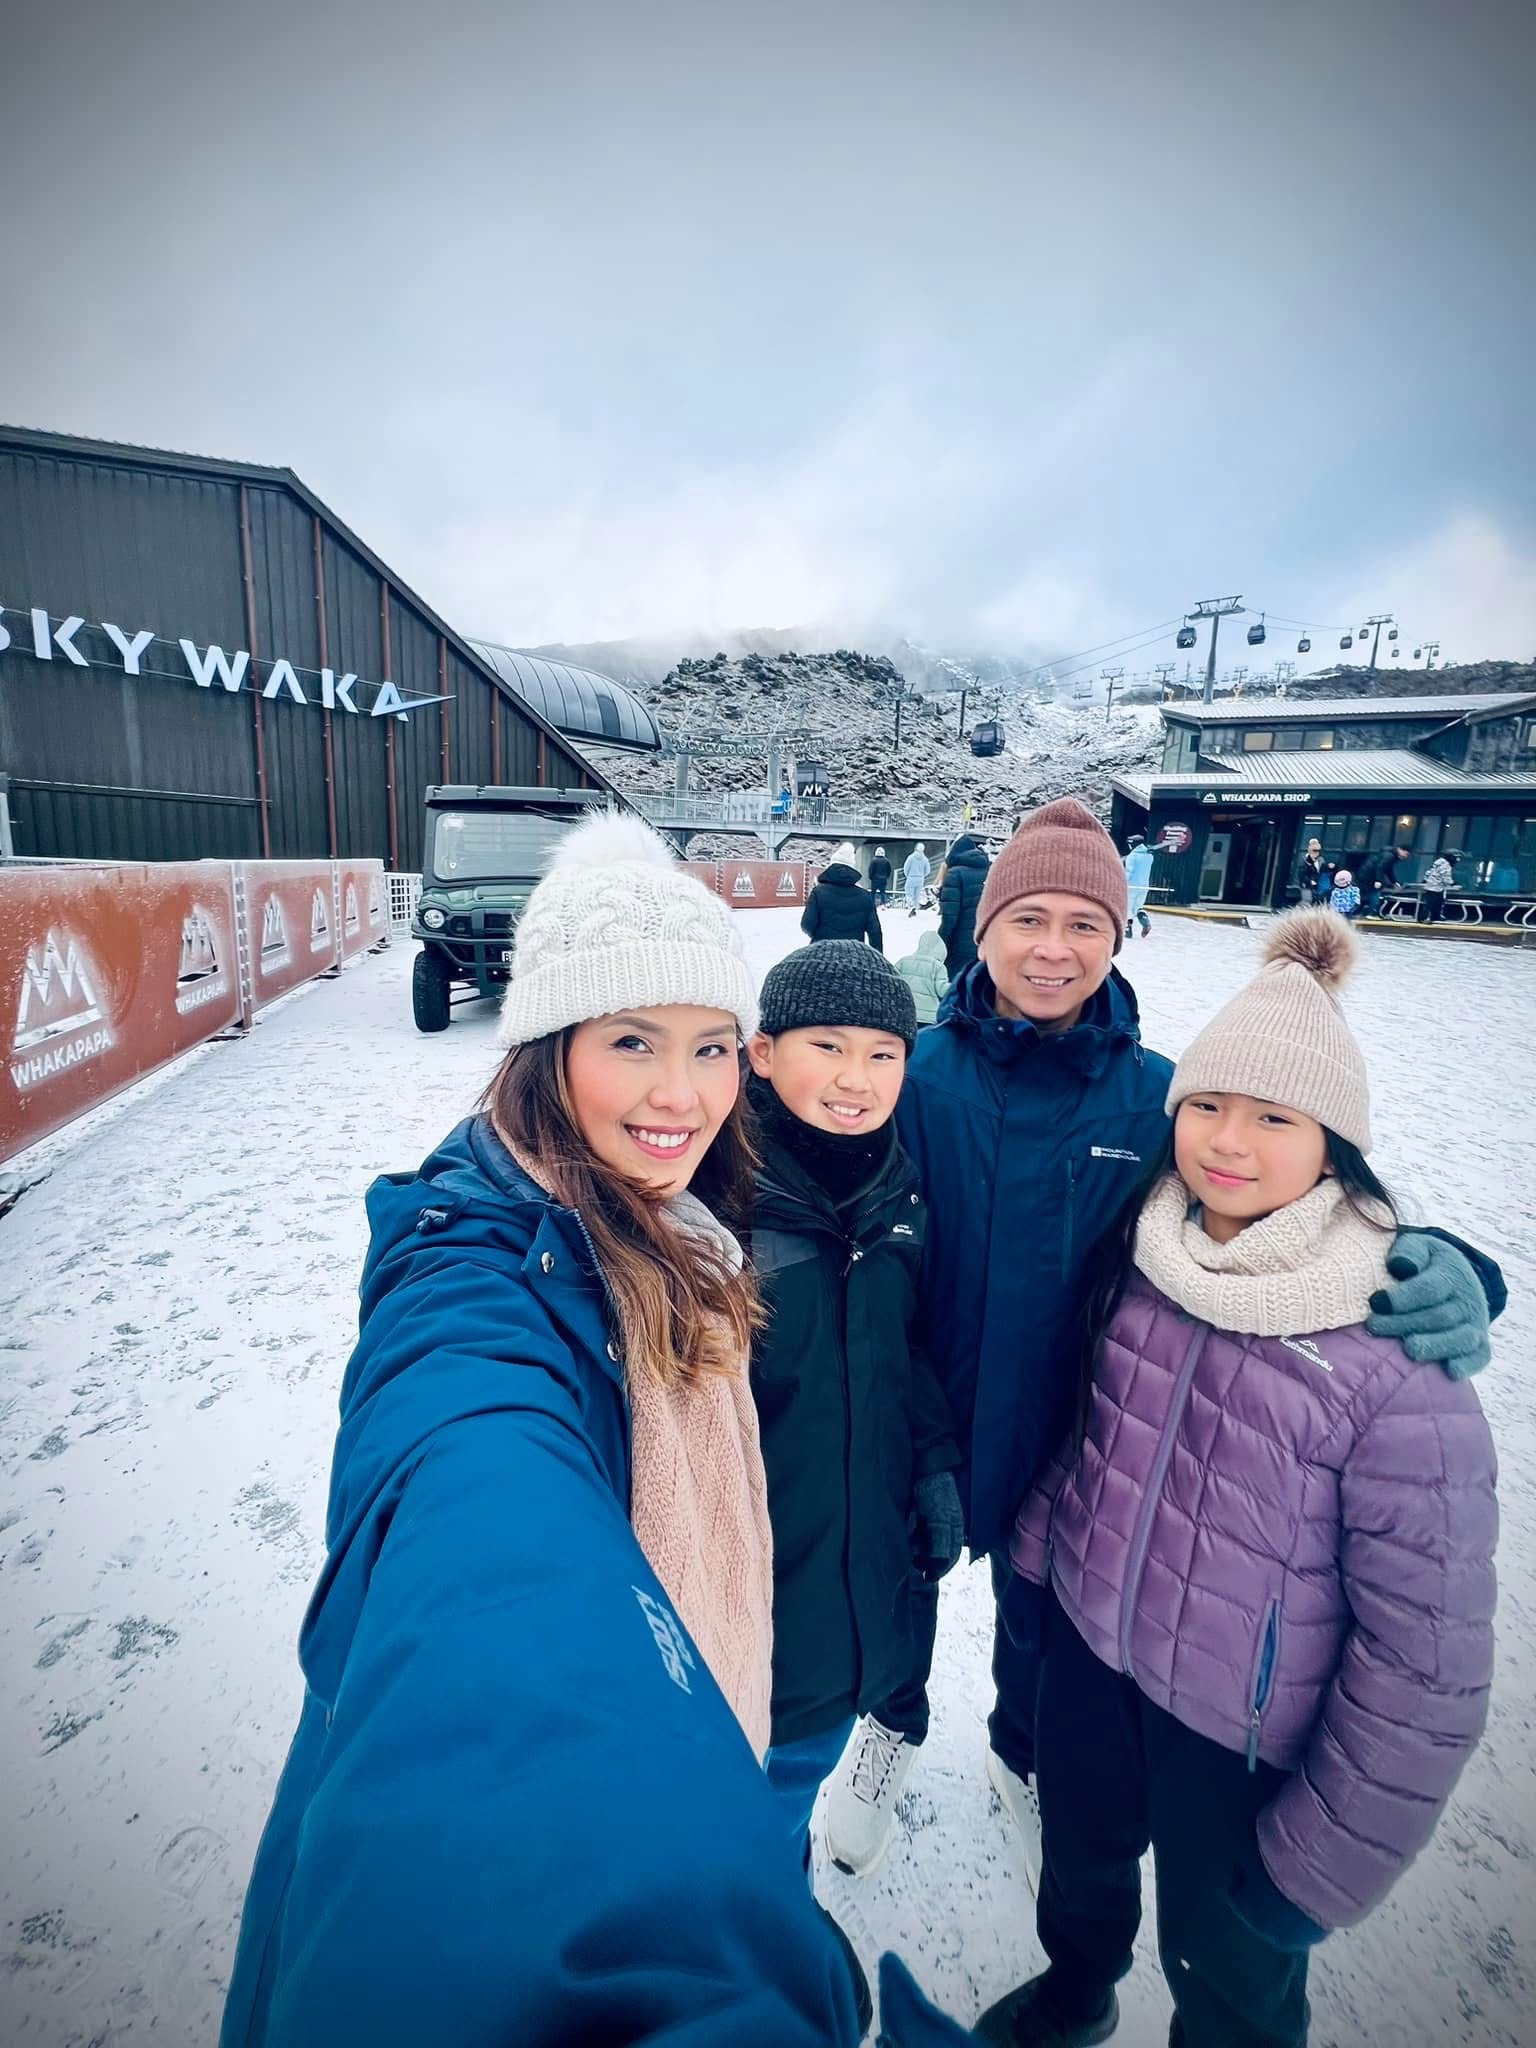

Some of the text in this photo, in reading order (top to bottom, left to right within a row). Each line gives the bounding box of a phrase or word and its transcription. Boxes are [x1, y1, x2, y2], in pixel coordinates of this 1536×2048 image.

[178, 638, 456, 722] WAKA
[1221, 793, 1311, 802] WHAKAPAPA SHOP
[10, 1029, 112, 1089] WHAKAPAPA
